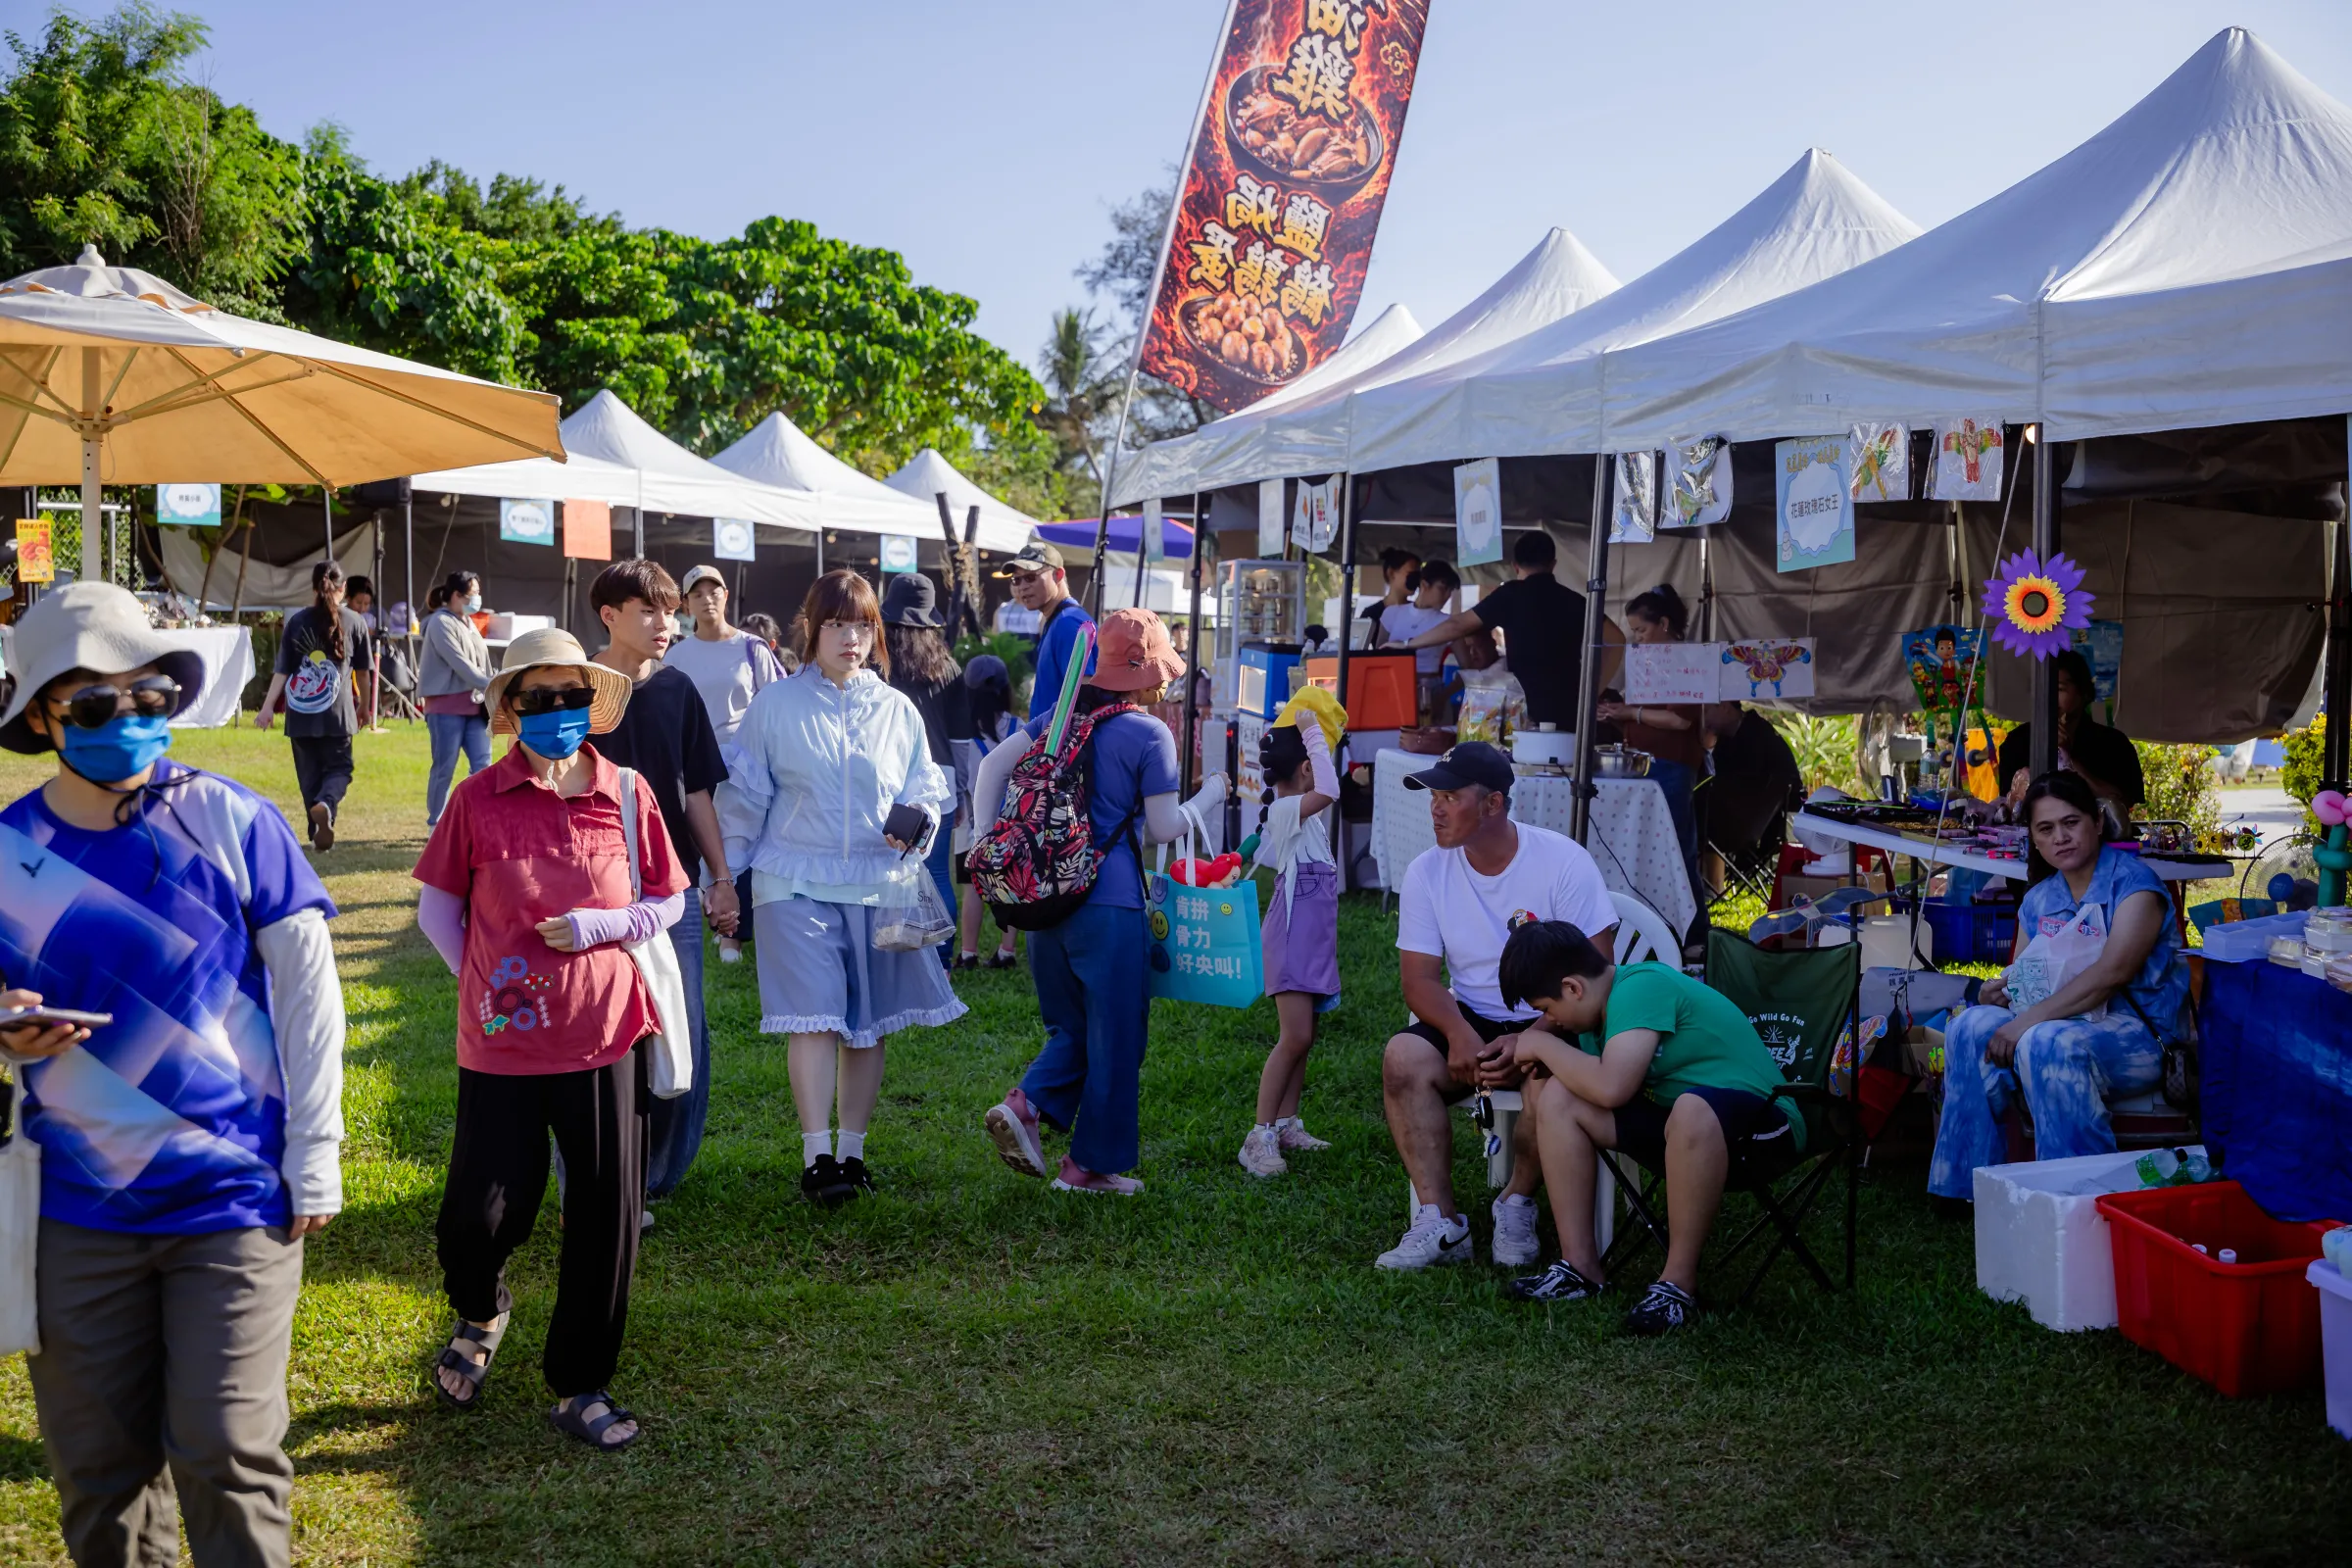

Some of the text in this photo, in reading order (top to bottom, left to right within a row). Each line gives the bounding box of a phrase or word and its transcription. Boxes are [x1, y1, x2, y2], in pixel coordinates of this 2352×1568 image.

[1176, 924, 1211, 950] 骨力
[1748, 1012, 1805, 1027] Go Wild Go Fun
